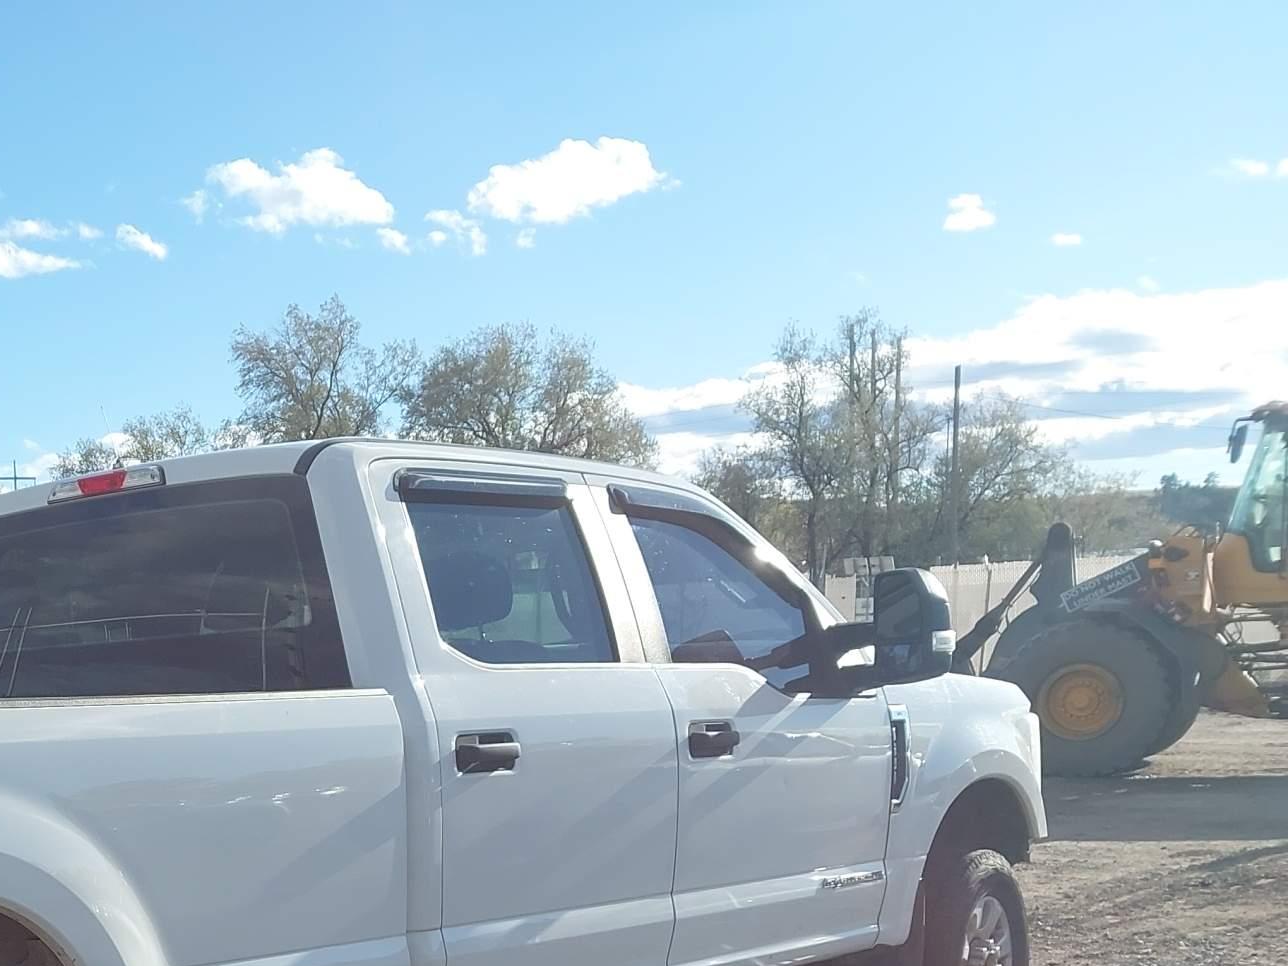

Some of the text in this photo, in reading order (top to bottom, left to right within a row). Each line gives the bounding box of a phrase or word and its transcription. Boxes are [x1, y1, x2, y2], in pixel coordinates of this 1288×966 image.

[1063, 562, 1134, 601] DO NOT WALK
